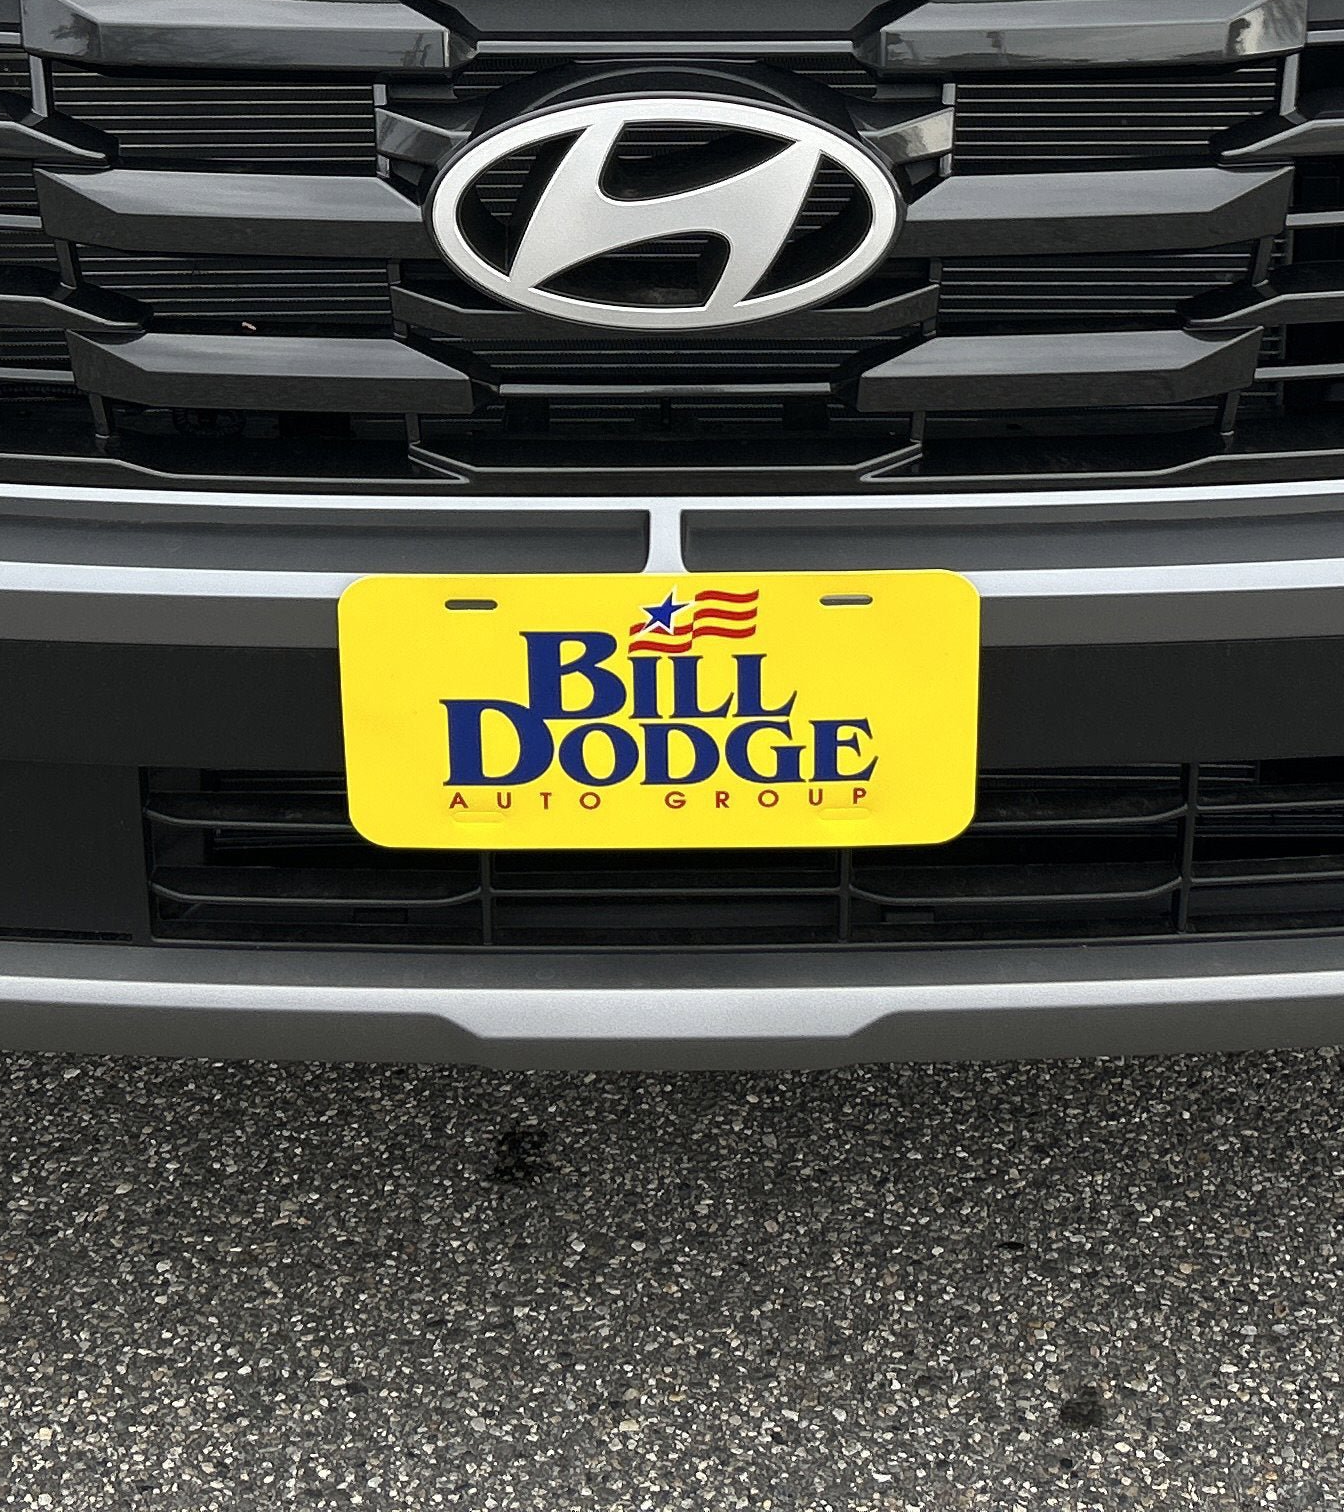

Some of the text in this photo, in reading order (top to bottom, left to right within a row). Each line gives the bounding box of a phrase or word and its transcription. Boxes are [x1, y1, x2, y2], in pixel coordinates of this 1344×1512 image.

[519, 630, 798, 720] BILL
[439, 699, 879, 786] DODGE
[449, 787, 868, 811] AUTO GROUP
